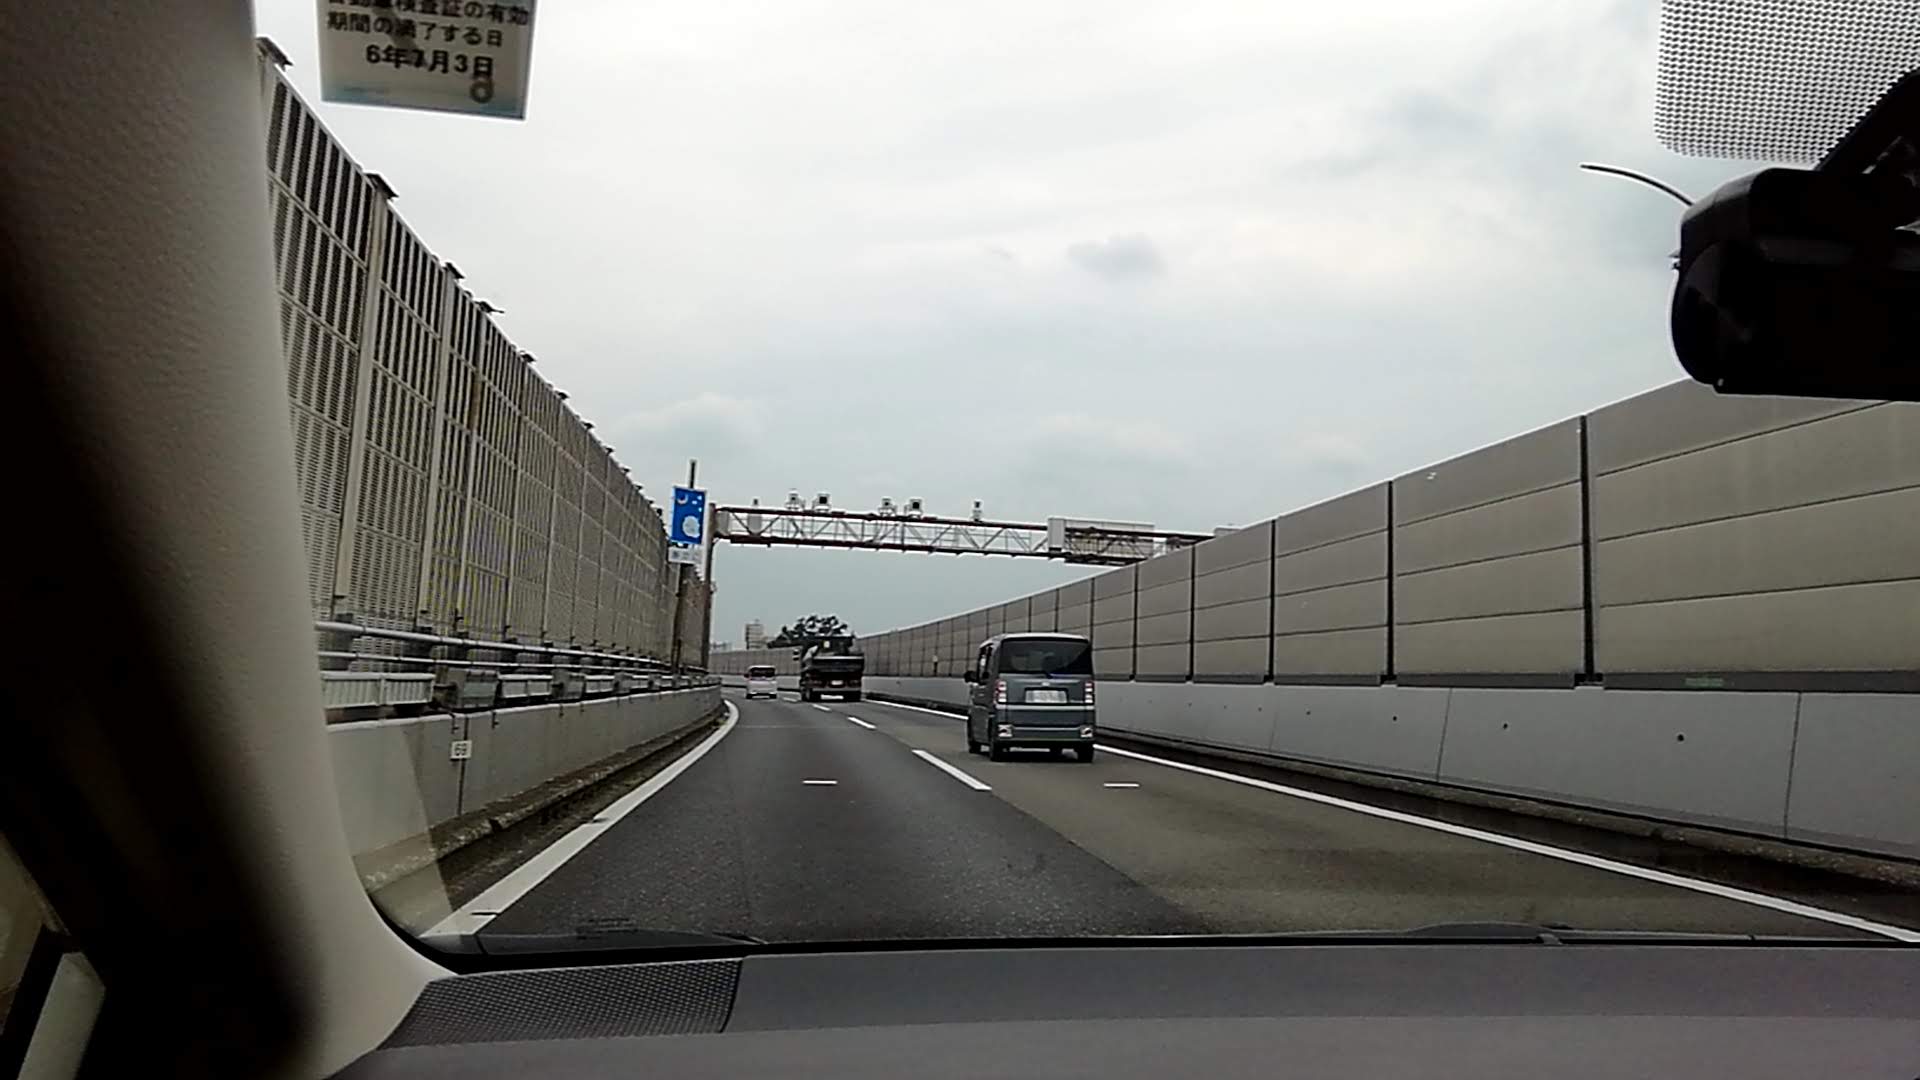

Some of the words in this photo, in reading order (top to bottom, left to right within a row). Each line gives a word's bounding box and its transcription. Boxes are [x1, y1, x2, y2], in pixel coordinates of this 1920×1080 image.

[327, 11, 504, 48] 期間の満了する日
